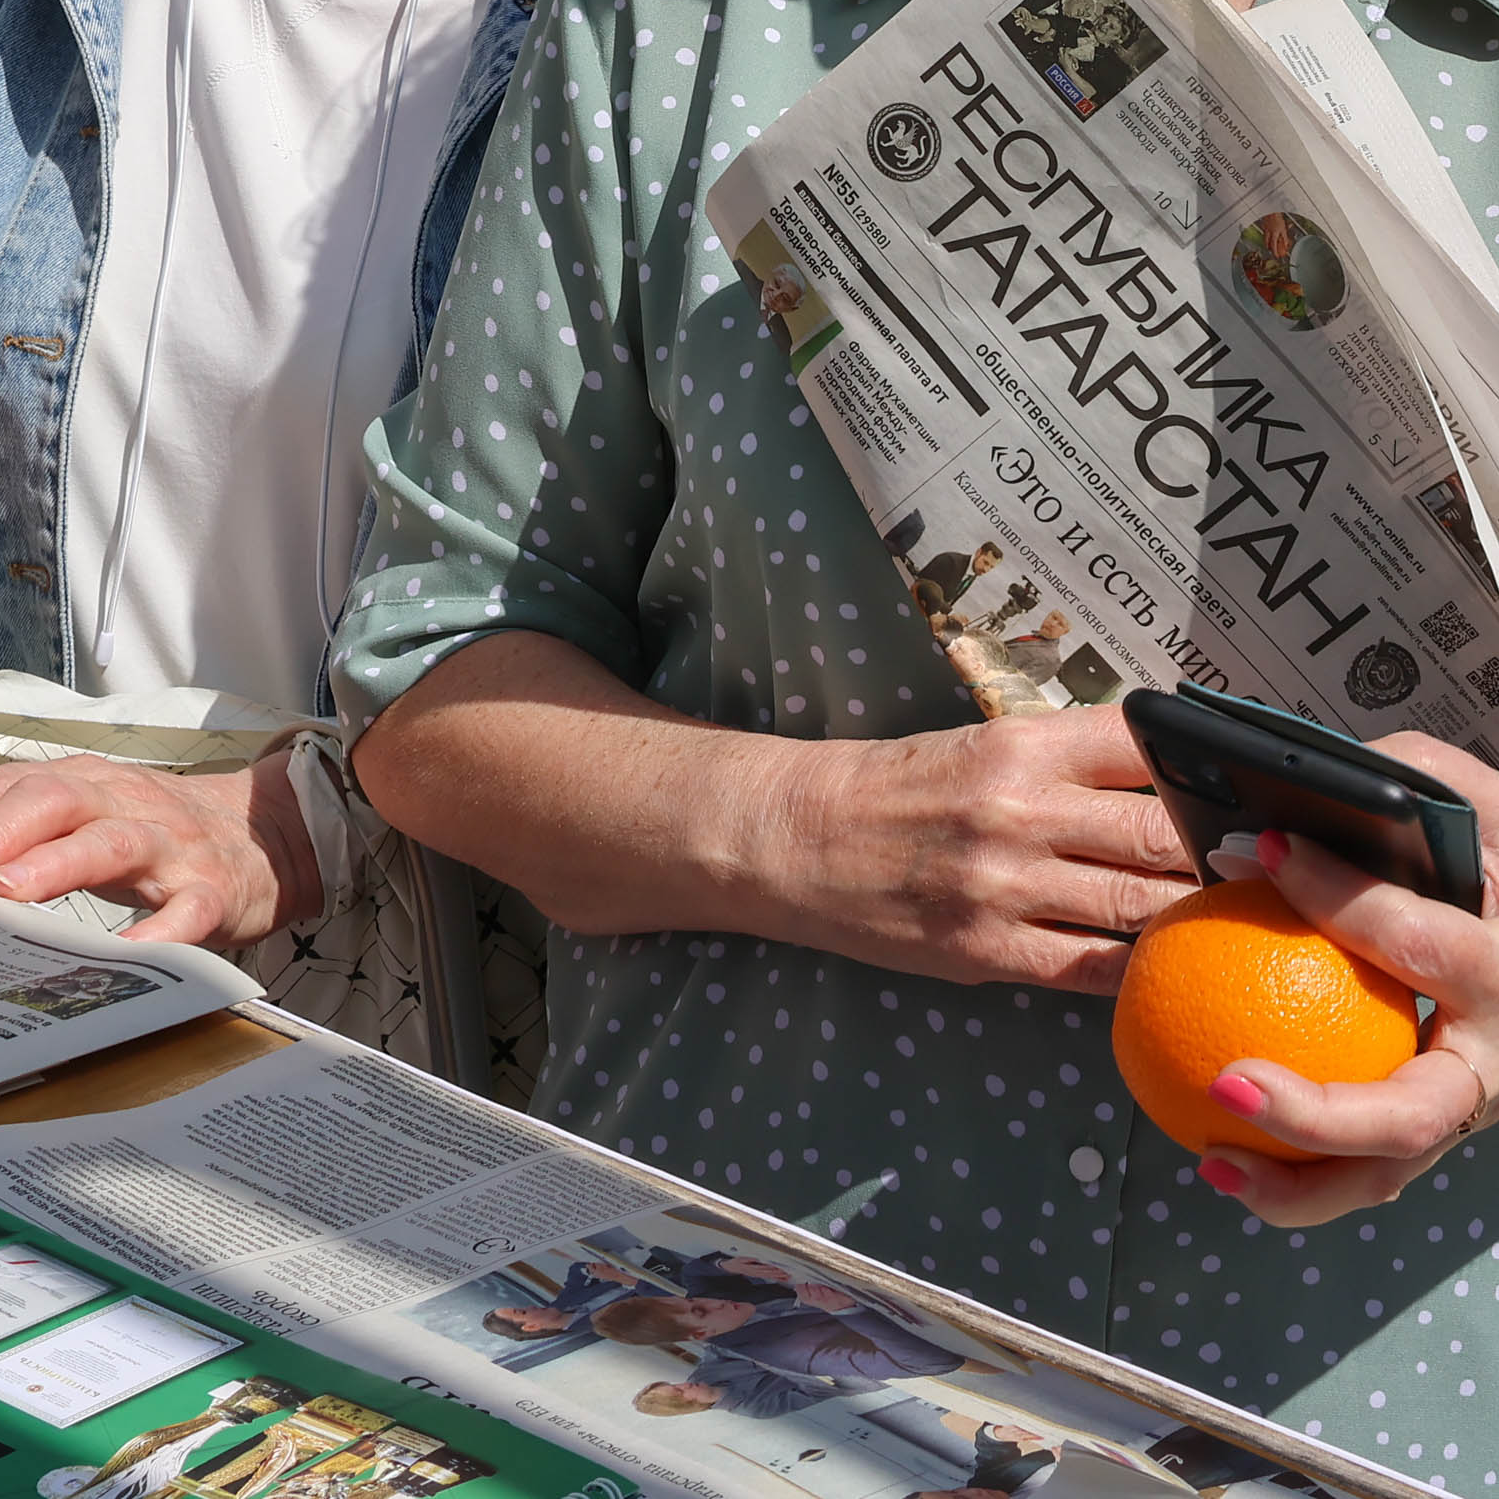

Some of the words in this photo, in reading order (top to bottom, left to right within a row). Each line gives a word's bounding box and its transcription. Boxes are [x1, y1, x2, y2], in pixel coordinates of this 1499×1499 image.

[1048, 67, 1081, 102] РОССИЯ
[1181, 72, 1256, 153] программа
[1247, 146, 1273, 172] TV
[1115, 107, 1160, 155] эпизода
[1126, 97, 1174, 149] смешная
[1167, 144, 1217, 198] королева
[1137, 87, 1196, 150] Чеснокова.
[1187, 145, 1225, 186] Яркая,
[1147, 77, 1200, 134] Гликерия
[1191, 128, 1251, 192] Богданова-
[796, 187, 829, 226] власть
[824, 222, 834, 234] и
[830, 229, 864, 271] бизнес
[819, 162, 862, 207] №55
[849, 204, 893, 251] (29580)
[1150, 188, 1174, 212] 10
[765, 204, 830, 282] объединяет
[920, 42, 1328, 511] РЕСПУБЛИКА
[775, 195, 898, 346] Торгово-промышленная
[891, 340, 932, 388] палата
[927, 382, 949, 407] РТ
[827, 356, 876, 417] народный
[871, 413, 907, 456] форум
[837, 348, 874, 393] открыл
[870, 389, 910, 438] Между-
[846, 338, 882, 382] Фарид
[880, 377, 941, 453] Мухаметшин
[928, 158, 1370, 656] ТАТАРСТАН
[1329, 345, 1368, 396] отходов
[1337, 337, 1357, 361] для
[1356, 360, 1423, 445] органических
[1347, 330, 1366, 353] два
[1365, 353, 1411, 412] полигона
[1358, 323, 1369, 335] В
[1366, 334, 1402, 381] Казани
[1398, 381, 1440, 436] создадут
[810, 372, 849, 418] ленных
[842, 416, 872, 452] палат
[818, 364, 900, 467] торгово-промыш-
[1367, 432, 1382, 447] 5
[971, 339, 1189, 579] общественно-политическая
[1181, 571, 1238, 632] газета
[950, 468, 1026, 549] KazanForum
[1015, 540, 1082, 612] открывает
[1073, 601, 1108, 639] окно
[980, 430, 1074, 528] «Это
[1055, 518, 1095, 558] и
[1083, 546, 1165, 632] есть
[1328, 509, 1404, 592] reklama@rt-online.ru
[1342, 481, 1428, 575] www.rt-online.ru
[1351, 516, 1414, 585] info@rt-online.ru
[7, 1184, 30, 1196] ДНЯ
[14, 1177, 62, 1204] СОСТОЯТСЯ
[22, 1194, 53, 1210] ЧЕСТЬ
[52, 1212, 113, 1247] МЕРОПРИЯТИЯ
[55, 1201, 121, 1240] ЖУРНАЛИСТИКИ
[107, 1245, 169, 1280] ПРАЗДНИЧНЫЕ
[116, 1238, 182, 1276] ТАТАРСТАНСКОЙ
[240, 1286, 328, 1329] скорбь
[509, 1396, 553, 1419] ЕГЭ
[540, 1411, 582, 1434] для
[565, 1427, 649, 1468] «ответы»
